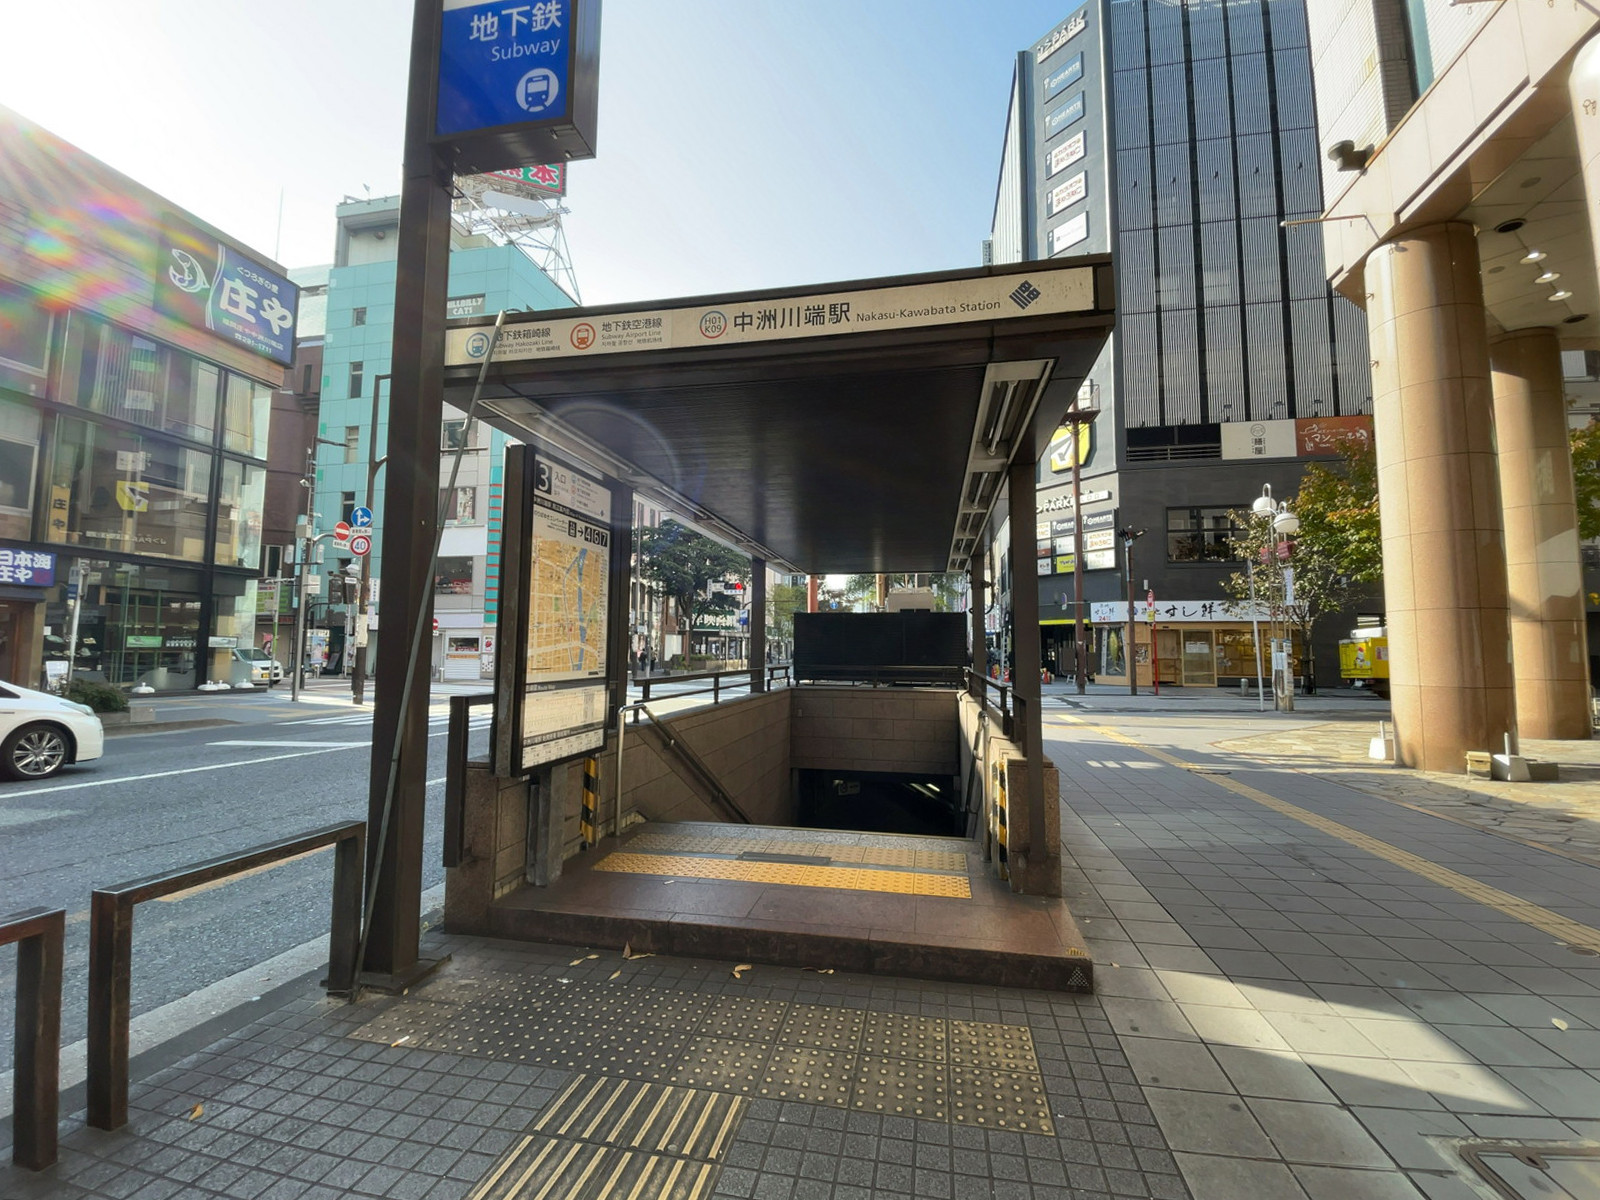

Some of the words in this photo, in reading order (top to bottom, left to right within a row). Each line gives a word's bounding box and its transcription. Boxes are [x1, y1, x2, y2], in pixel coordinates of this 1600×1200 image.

[469, 1, 562, 42] 地下鉄
[491, 39, 561, 62] Subway
[220, 276, 293, 336] 庄や
[856, 304, 956, 323] Nakasu-Kawabata
[959, 299, 1001, 313] Station
[601, 317, 662, 332] 地下鉄空港線
[704, 316, 722, 325] H01
[733, 301, 850, 333] 中洲川端駅
[625, 331, 648, 339] Airport
[704, 324, 722, 333] K09
[495, 342, 514, 350] ubway
[538, 463, 549, 491] 3
[554, 471, 567, 485] 入口
[52, 498, 67, 530] 庄や
[354, 540, 367, 551] 40
[585, 526, 592, 540] 4
[593, 529, 600, 544] 6
[601, 532, 607, 546] 7
[1164, 602, 1218, 620] すし鮮
